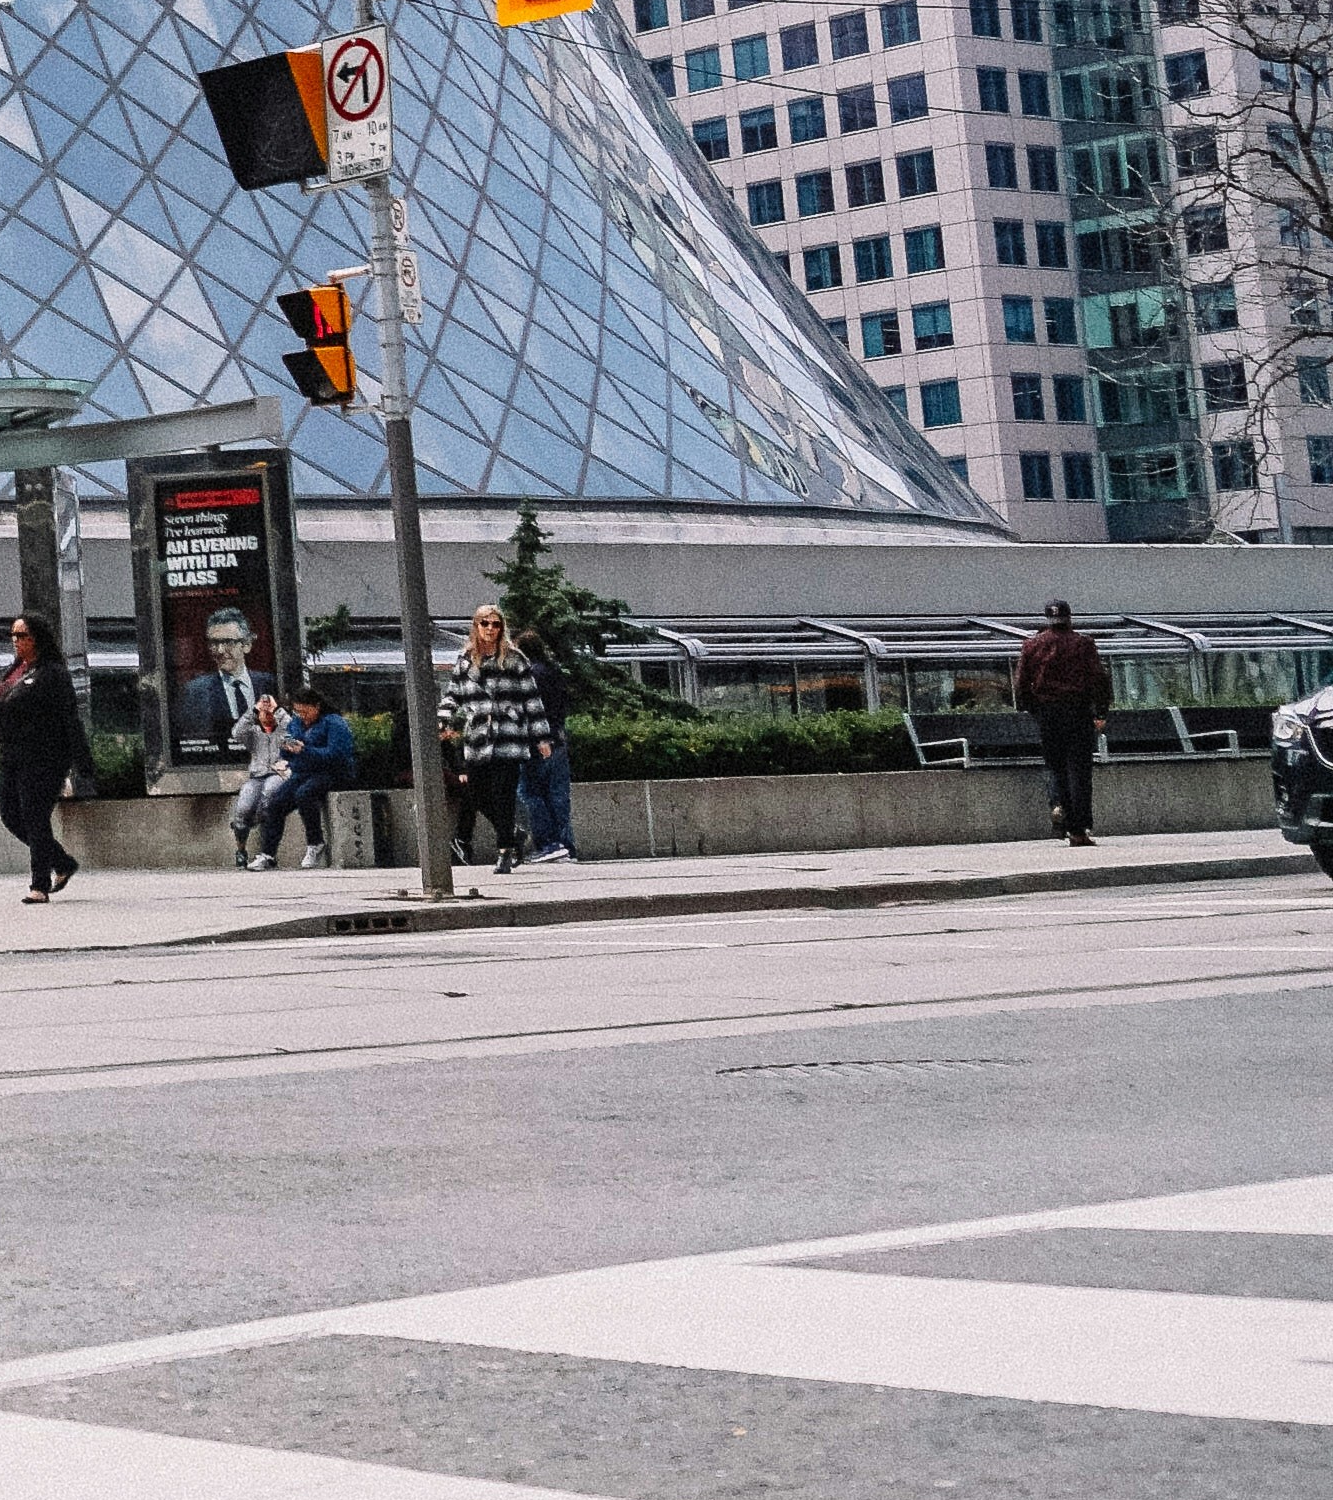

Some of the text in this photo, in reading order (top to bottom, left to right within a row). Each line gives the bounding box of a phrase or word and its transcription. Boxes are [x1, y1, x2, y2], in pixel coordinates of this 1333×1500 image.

[166, 535, 259, 555] AN EVENING
[167, 553, 239, 571] WITH IRA
[167, 570, 218, 588] GLASS
